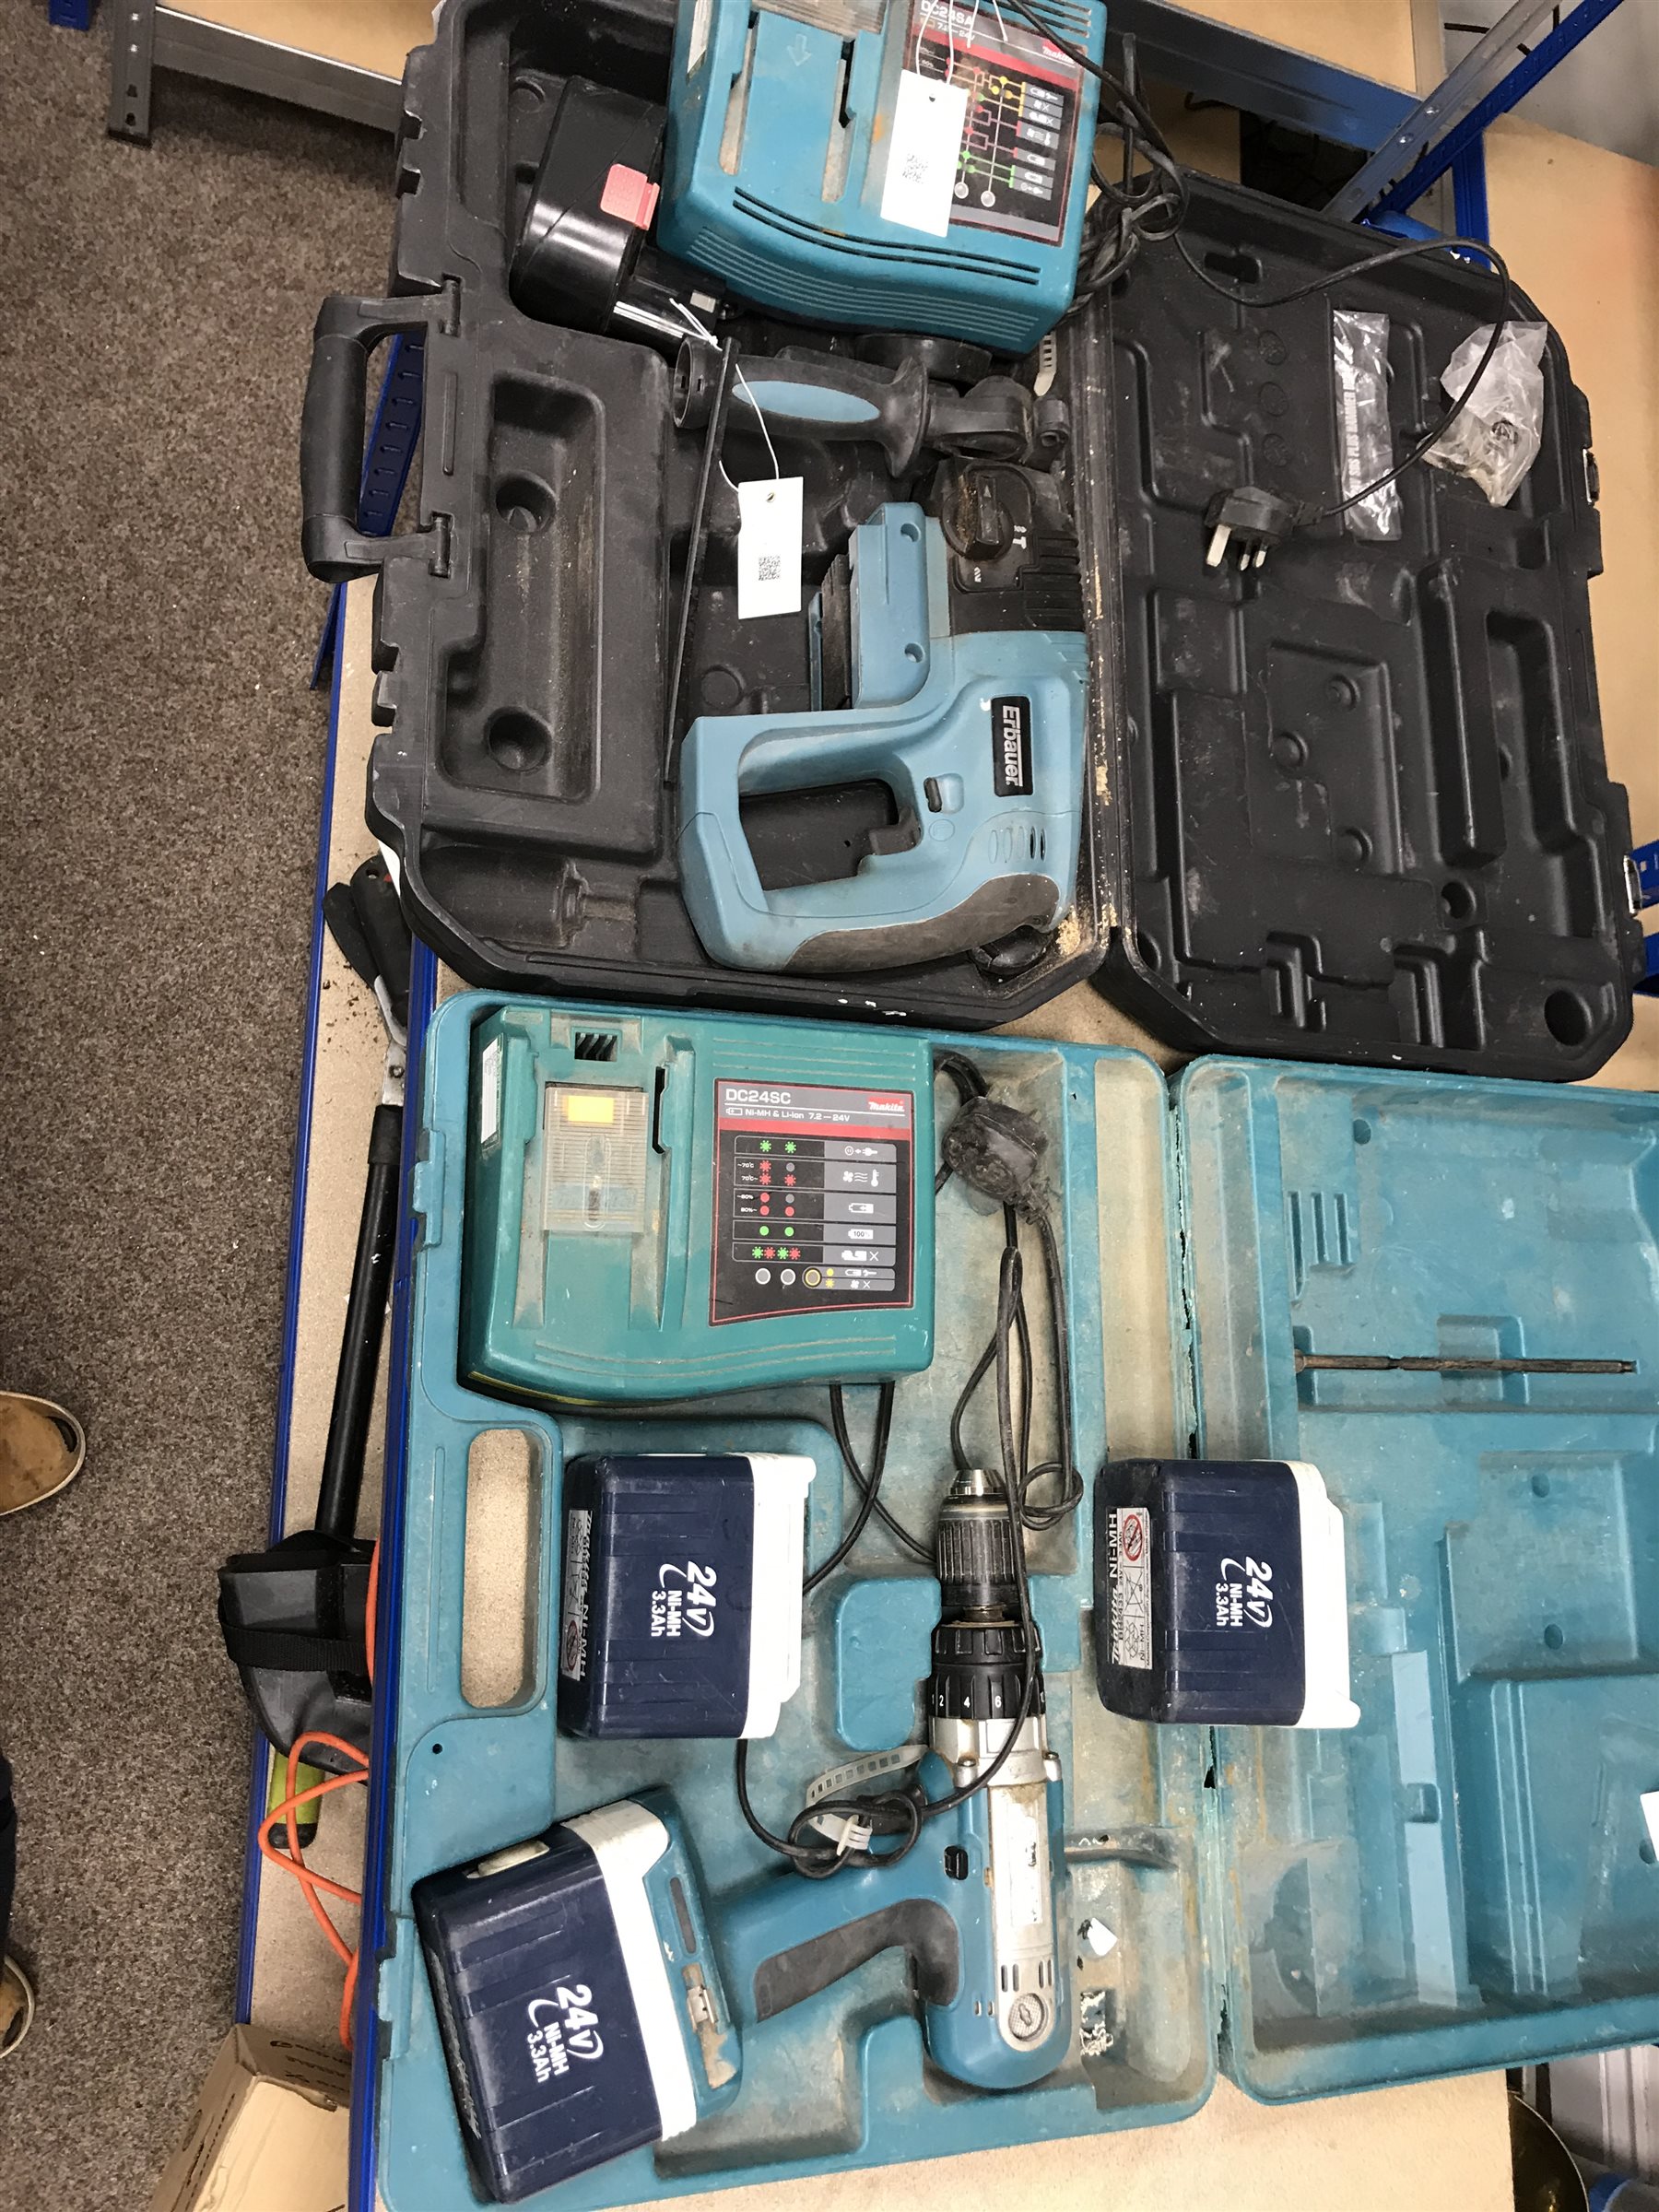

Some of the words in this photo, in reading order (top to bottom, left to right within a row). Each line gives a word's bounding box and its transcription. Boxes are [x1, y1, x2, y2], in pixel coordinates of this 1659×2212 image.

[725, 1088, 791, 1104] DC24SC
[745, 1107, 771, 1117] Ni-MH
[772, 1109, 780, 1117] &
[809, 1112, 822, 1121] 7.2
[1109, 1513, 1117, 1578] Ni-MH
[651, 1590, 666, 1637] 3.3Ah
[1216, 1583, 1230, 1627] 3.3Ah
[938, 1694, 945, 1707] 2
[963, 1696, 971, 1708] 4
[994, 1695, 1002, 1708] 6
[527, 2030, 552, 2083] 3.3Ah
